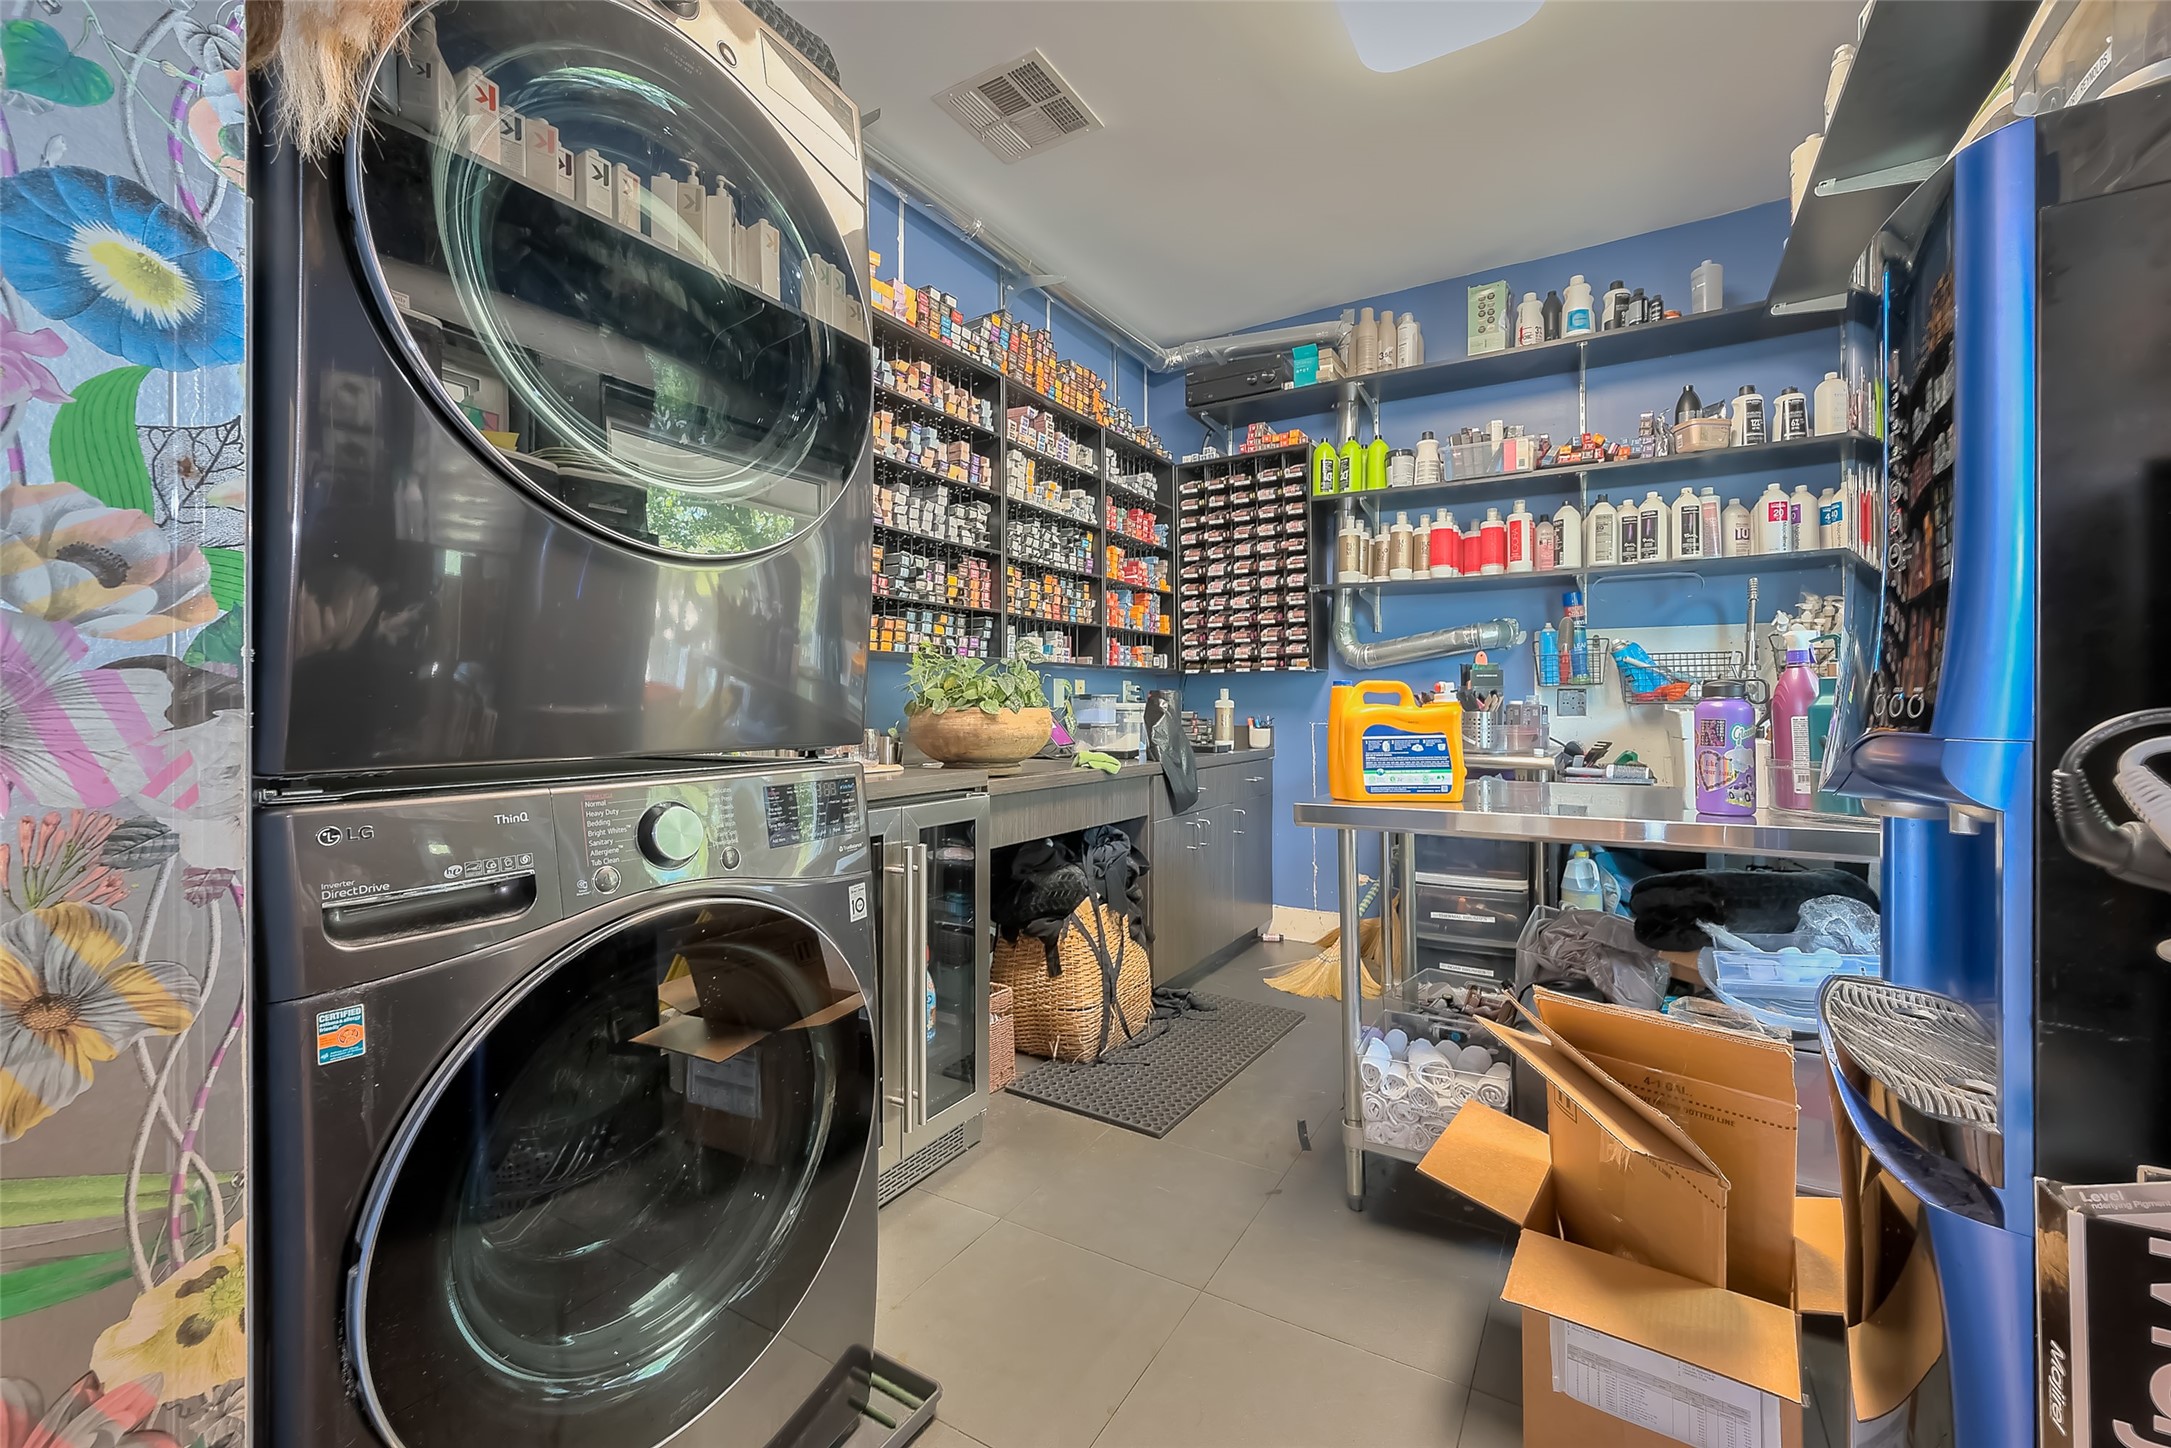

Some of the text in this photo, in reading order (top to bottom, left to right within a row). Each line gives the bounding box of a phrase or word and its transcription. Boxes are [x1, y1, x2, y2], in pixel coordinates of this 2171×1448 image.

[1773, 508, 1784, 518] 20
[585, 800, 607, 808] Normal
[494, 812, 529, 825] ThinQ
[586, 819, 611, 828] Bedding
[346, 825, 375, 841] LG
[587, 830, 606, 838] Bright
[588, 839, 613, 847] Sanitary
[591, 857, 620, 867] Tub Clean
[321, 879, 355, 890] Inverter
[319, 1008, 361, 1023] CERTIFIED
[1716, 1116, 1736, 1127] LINE
[2079, 1190, 2124, 1203] Level
[2090, 1202, 2133, 1210] nderlying
[2049, 1339, 2067, 1437] Majirel
